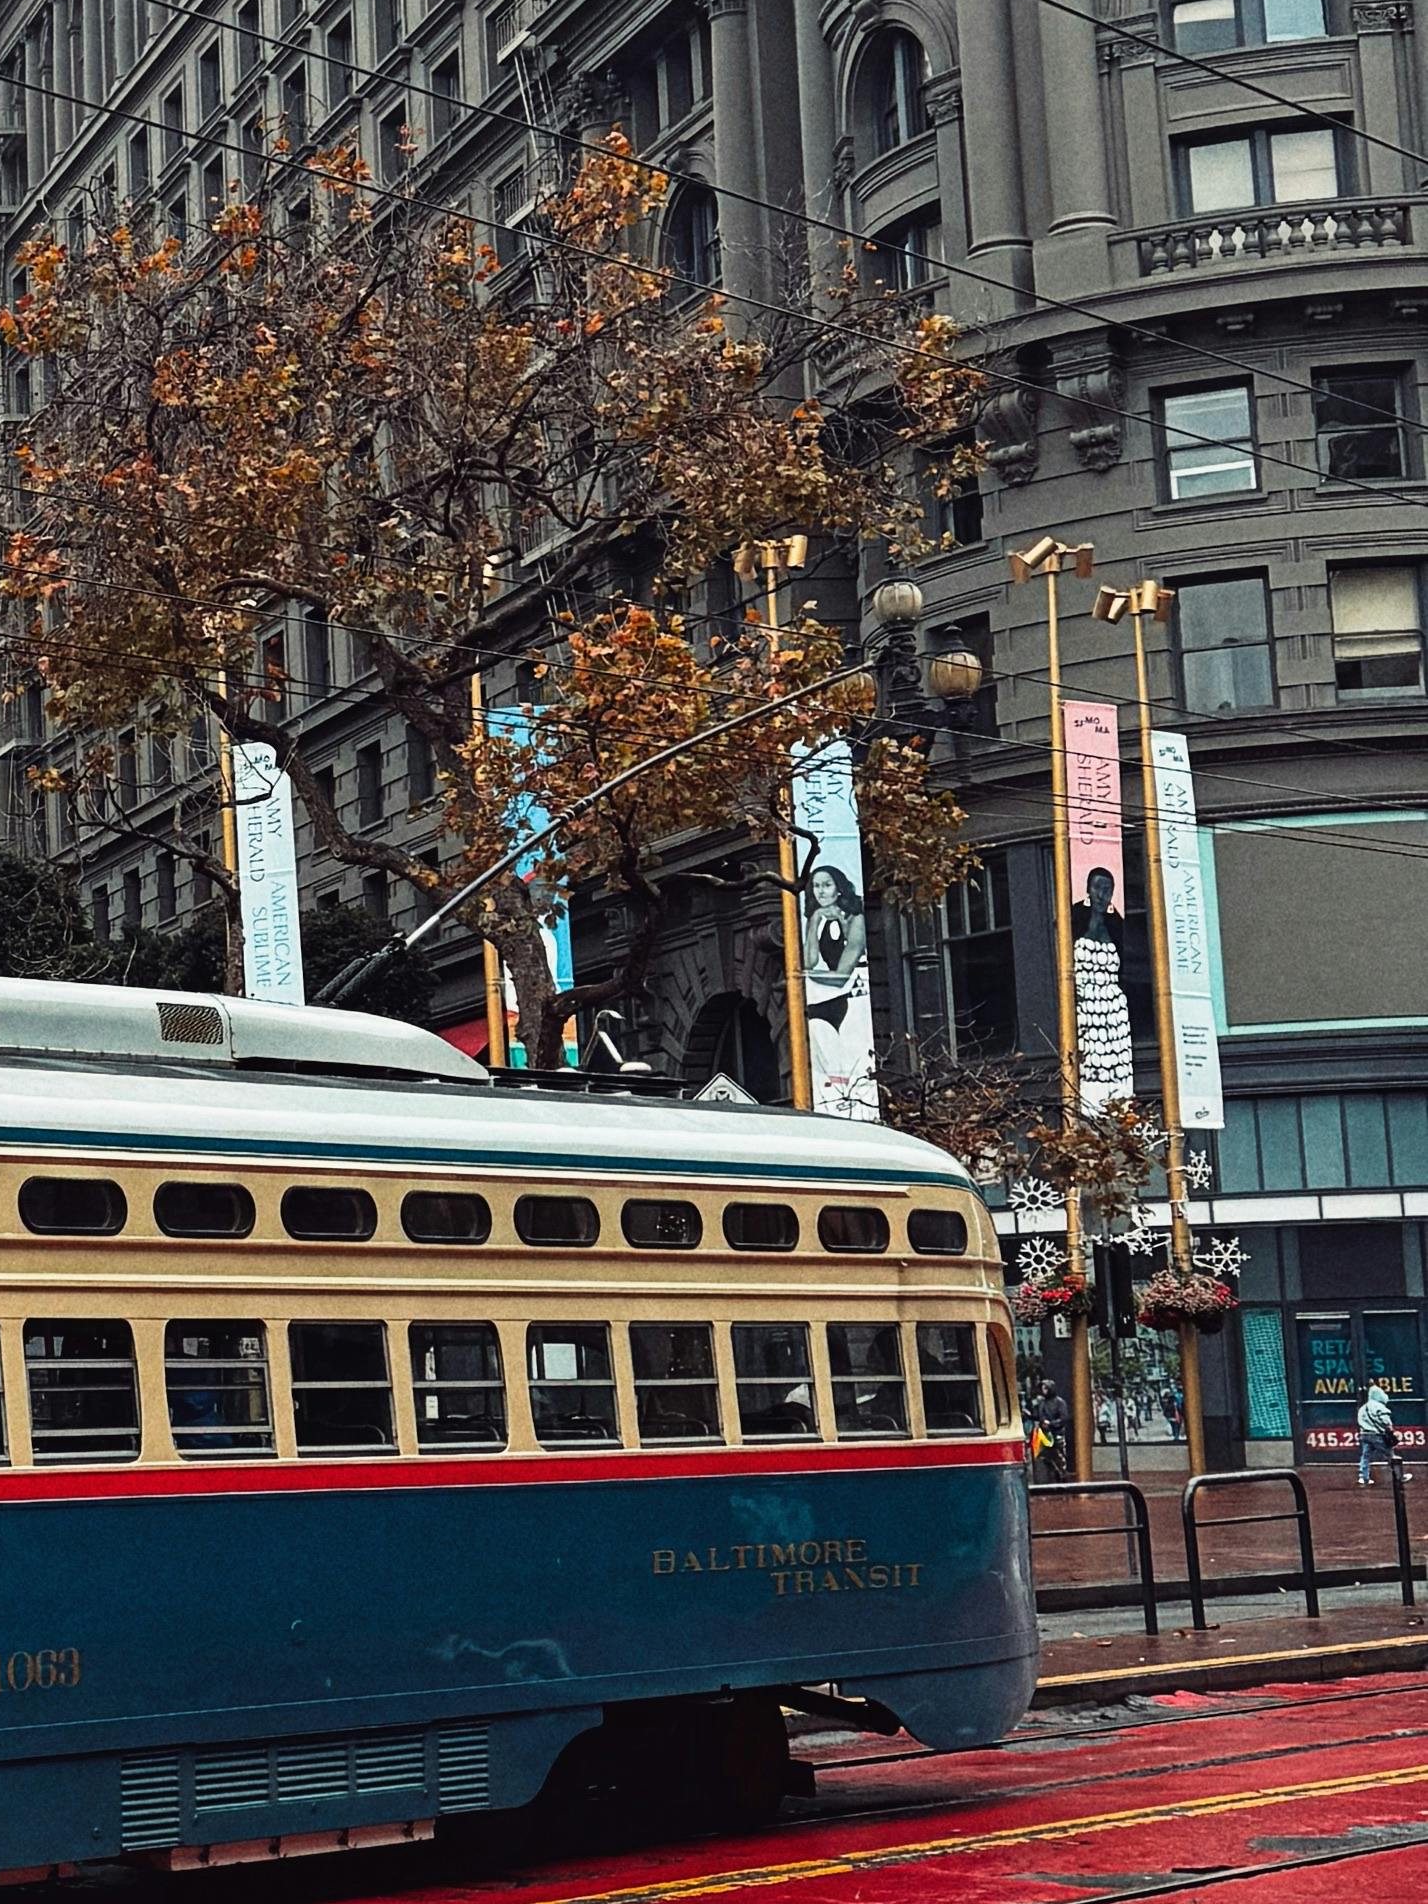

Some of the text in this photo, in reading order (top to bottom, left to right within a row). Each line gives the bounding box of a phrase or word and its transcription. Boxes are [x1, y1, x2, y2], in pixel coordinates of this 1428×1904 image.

[247, 805, 266, 884] HERALD
[252, 907, 271, 989] SUBLIME
[271, 881, 292, 987] AMERICAN
[1172, 891, 1191, 977] SUBLIME
[1183, 869, 1203, 976] AMERICAN
[652, 1539, 868, 1575] BALTIMORE
[770, 1563, 924, 1596] TRANSIT
